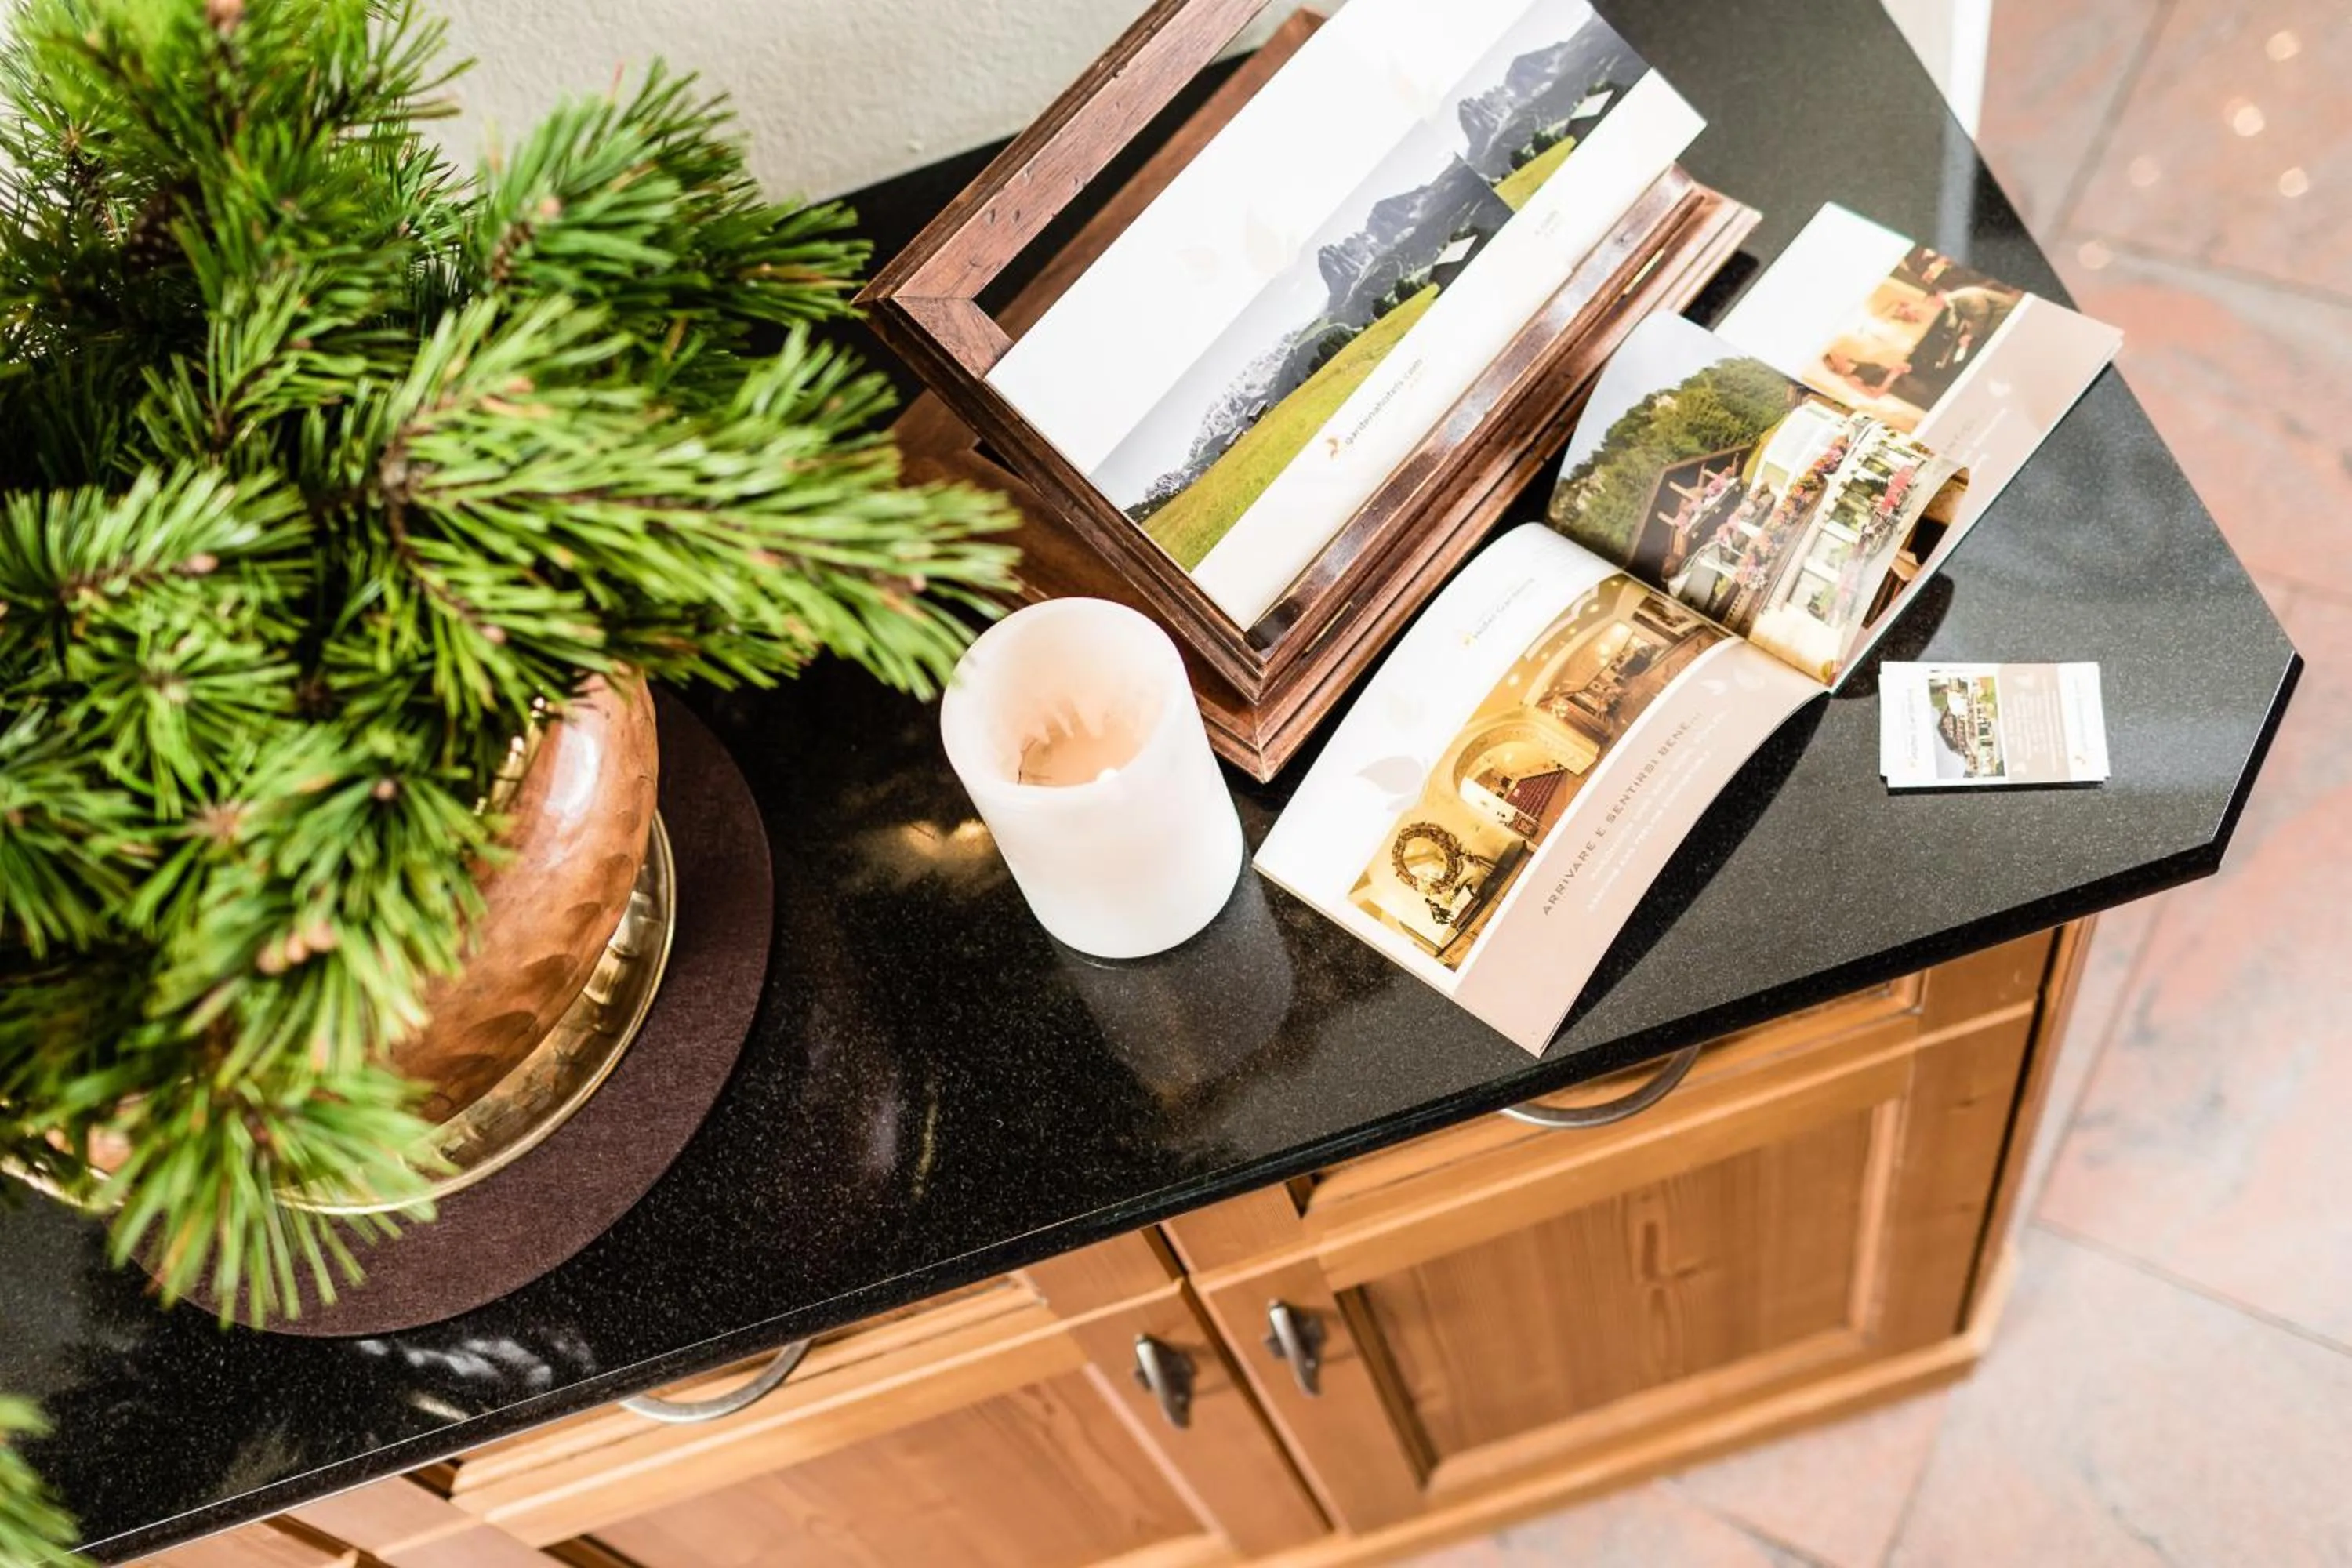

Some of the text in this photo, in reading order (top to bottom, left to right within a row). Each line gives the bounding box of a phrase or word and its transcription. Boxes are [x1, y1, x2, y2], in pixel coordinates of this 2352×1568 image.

[1542, 840, 1596, 916] ARRIVARE
[1595, 826, 1606, 837] E
[1605, 758, 1659, 824] SENTIRSI
